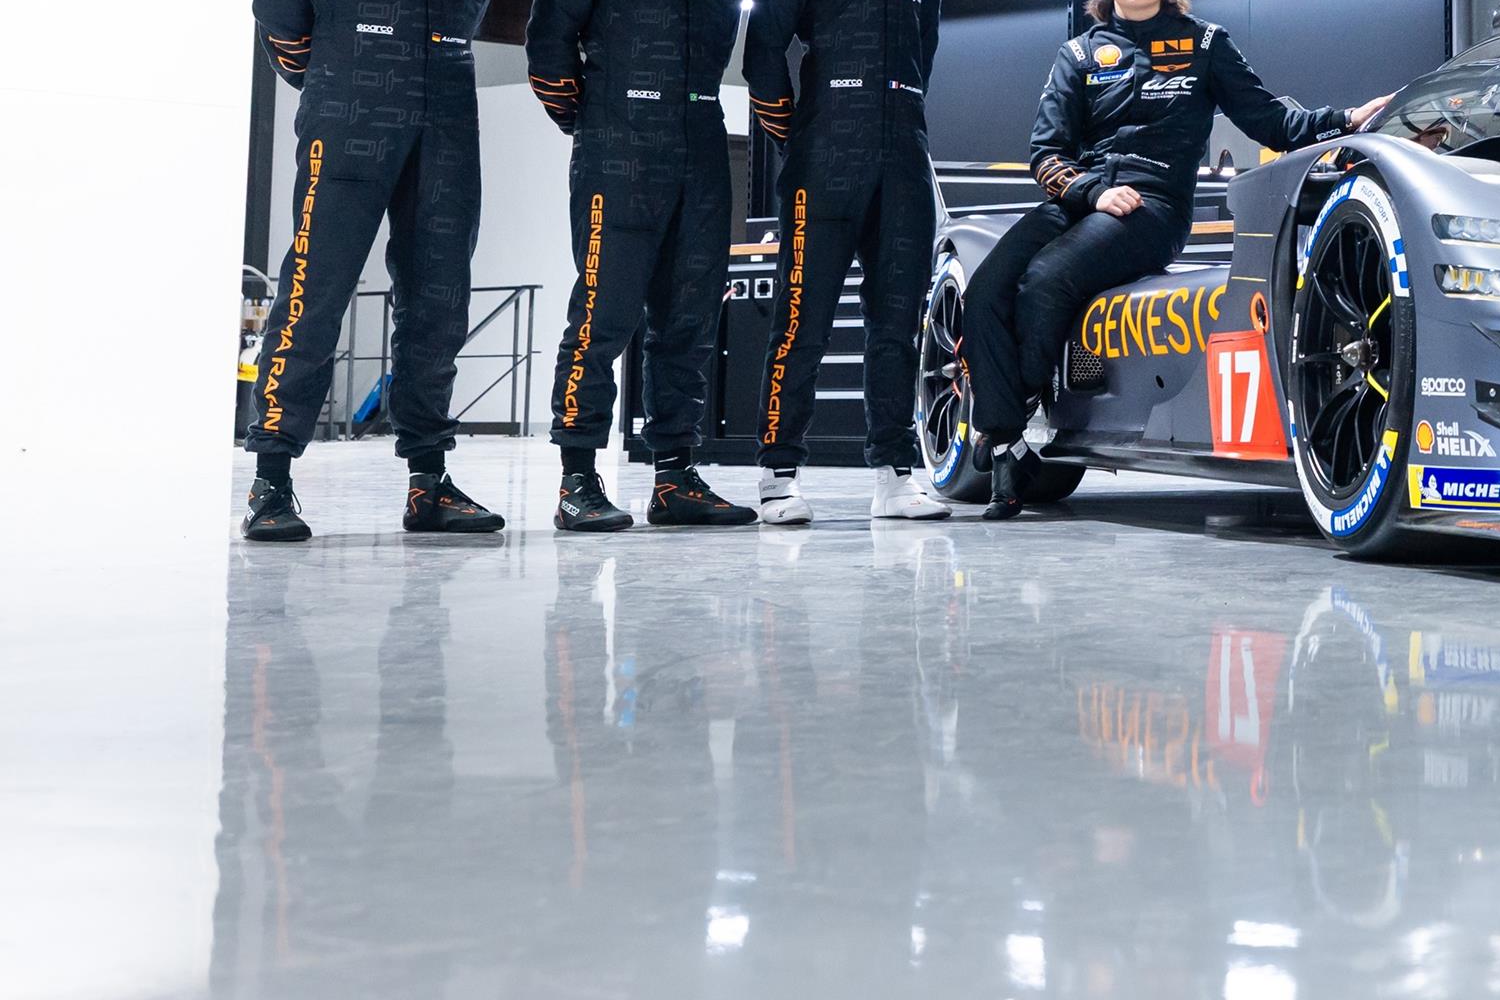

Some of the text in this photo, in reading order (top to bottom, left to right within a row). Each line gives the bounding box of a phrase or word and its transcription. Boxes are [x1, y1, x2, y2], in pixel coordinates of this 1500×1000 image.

[356, 23, 393, 35] sparco
[626, 89, 661, 100] sparco
[830, 79, 863, 87] sparco
[1142, 76, 1198, 90] WEC
[585, 193, 604, 287] GENESIS
[790, 188, 807, 285] GENESIS
[275, 258, 307, 352] MAGMA
[776, 288, 802, 361] MAGMA
[764, 364, 785, 444] RACING
[1218, 350, 1260, 443] 17
[1421, 377, 1466, 396] sparco
[1437, 422, 1459, 435] Shell
[1437, 430, 1496, 457] HELIX
[1334, 469, 1381, 531] MICHELIN
